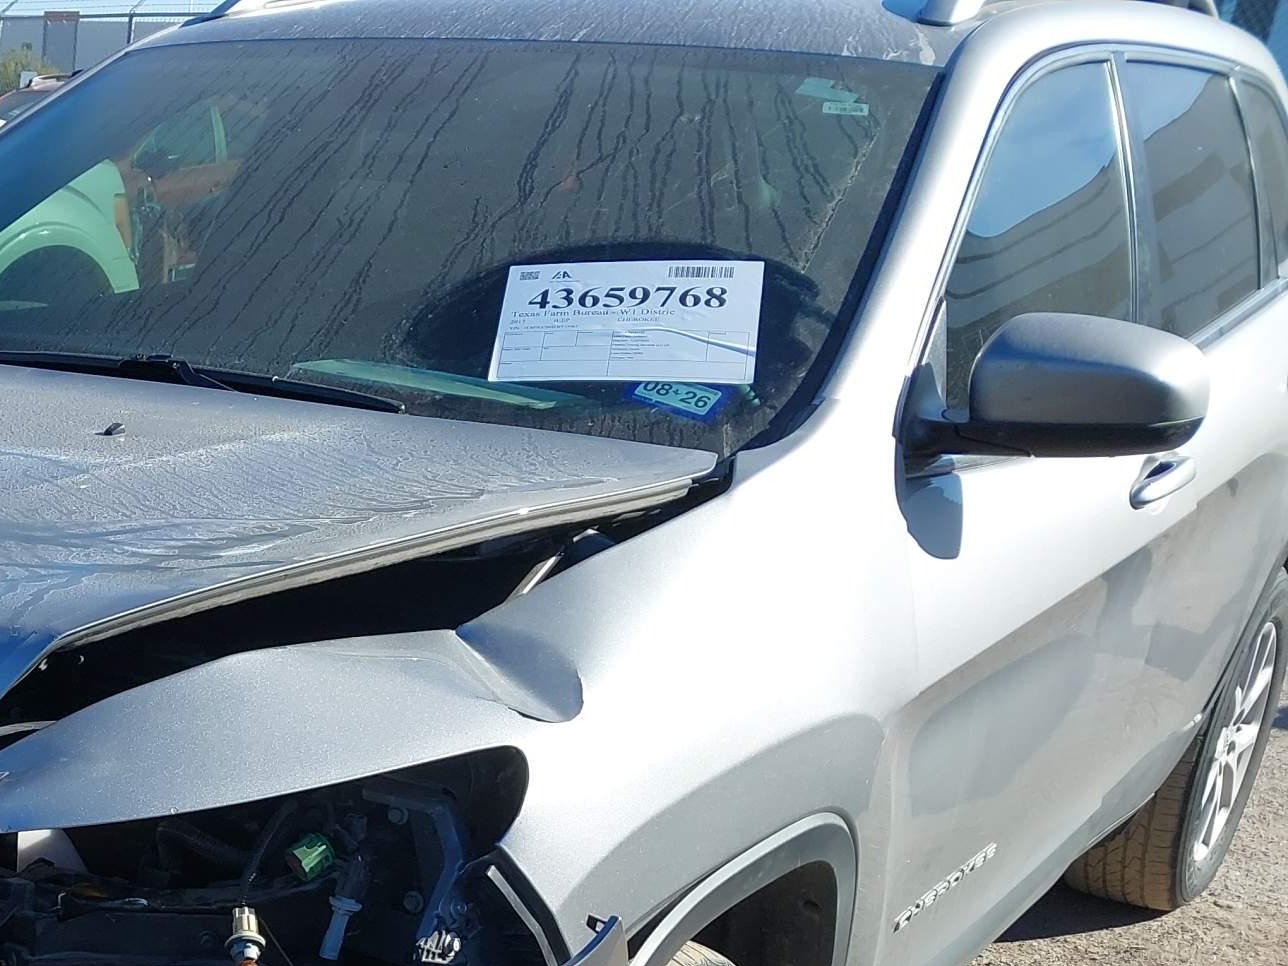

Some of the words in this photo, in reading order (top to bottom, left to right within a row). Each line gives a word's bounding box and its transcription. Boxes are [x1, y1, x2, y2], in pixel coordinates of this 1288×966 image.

[527, 285, 728, 310] 43659768
[543, 309, 570, 317] Farm
[679, 391, 712, 409] 26
